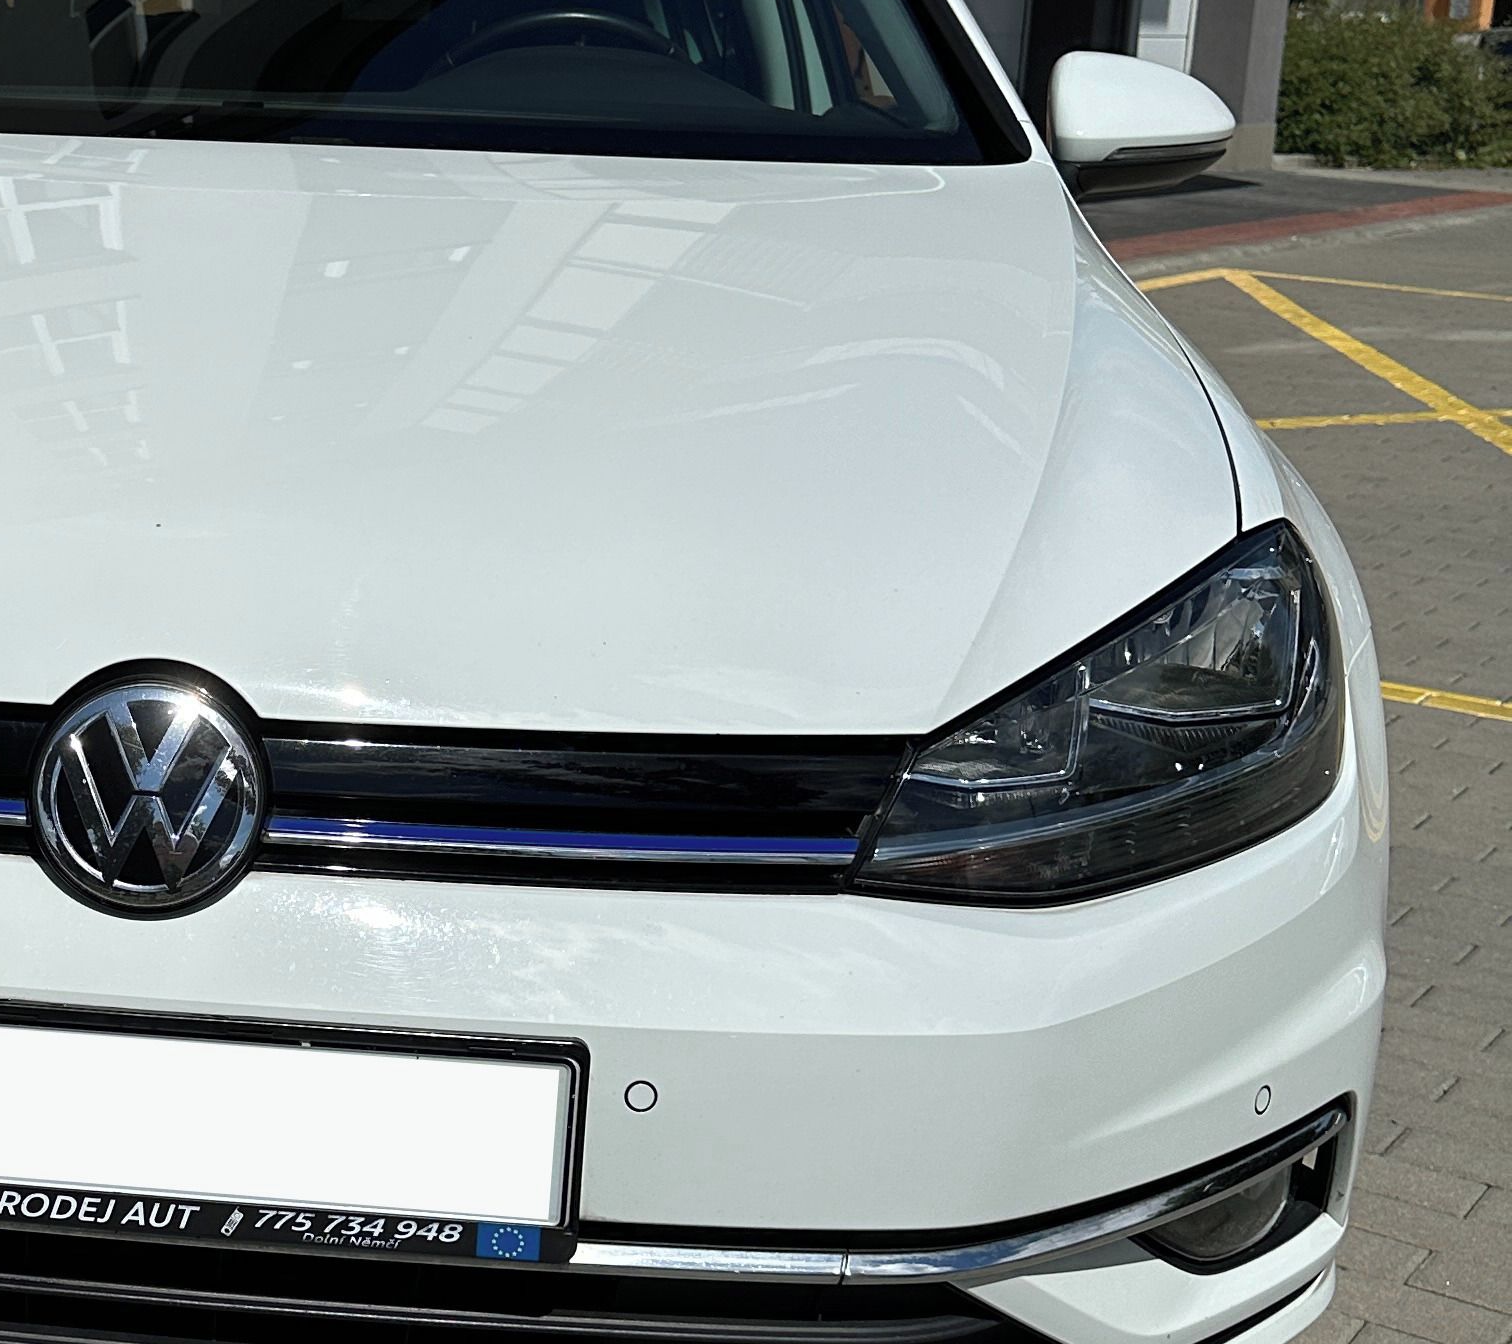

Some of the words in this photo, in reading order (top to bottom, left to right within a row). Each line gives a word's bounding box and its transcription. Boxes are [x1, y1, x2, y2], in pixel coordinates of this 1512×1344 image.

[120, 1201, 201, 1230] AUT
[254, 1209, 316, 1232] 775
[323, 1214, 386, 1237] 734
[394, 1220, 464, 1243] 948
[302, 1232, 346, 1245] Dolní
